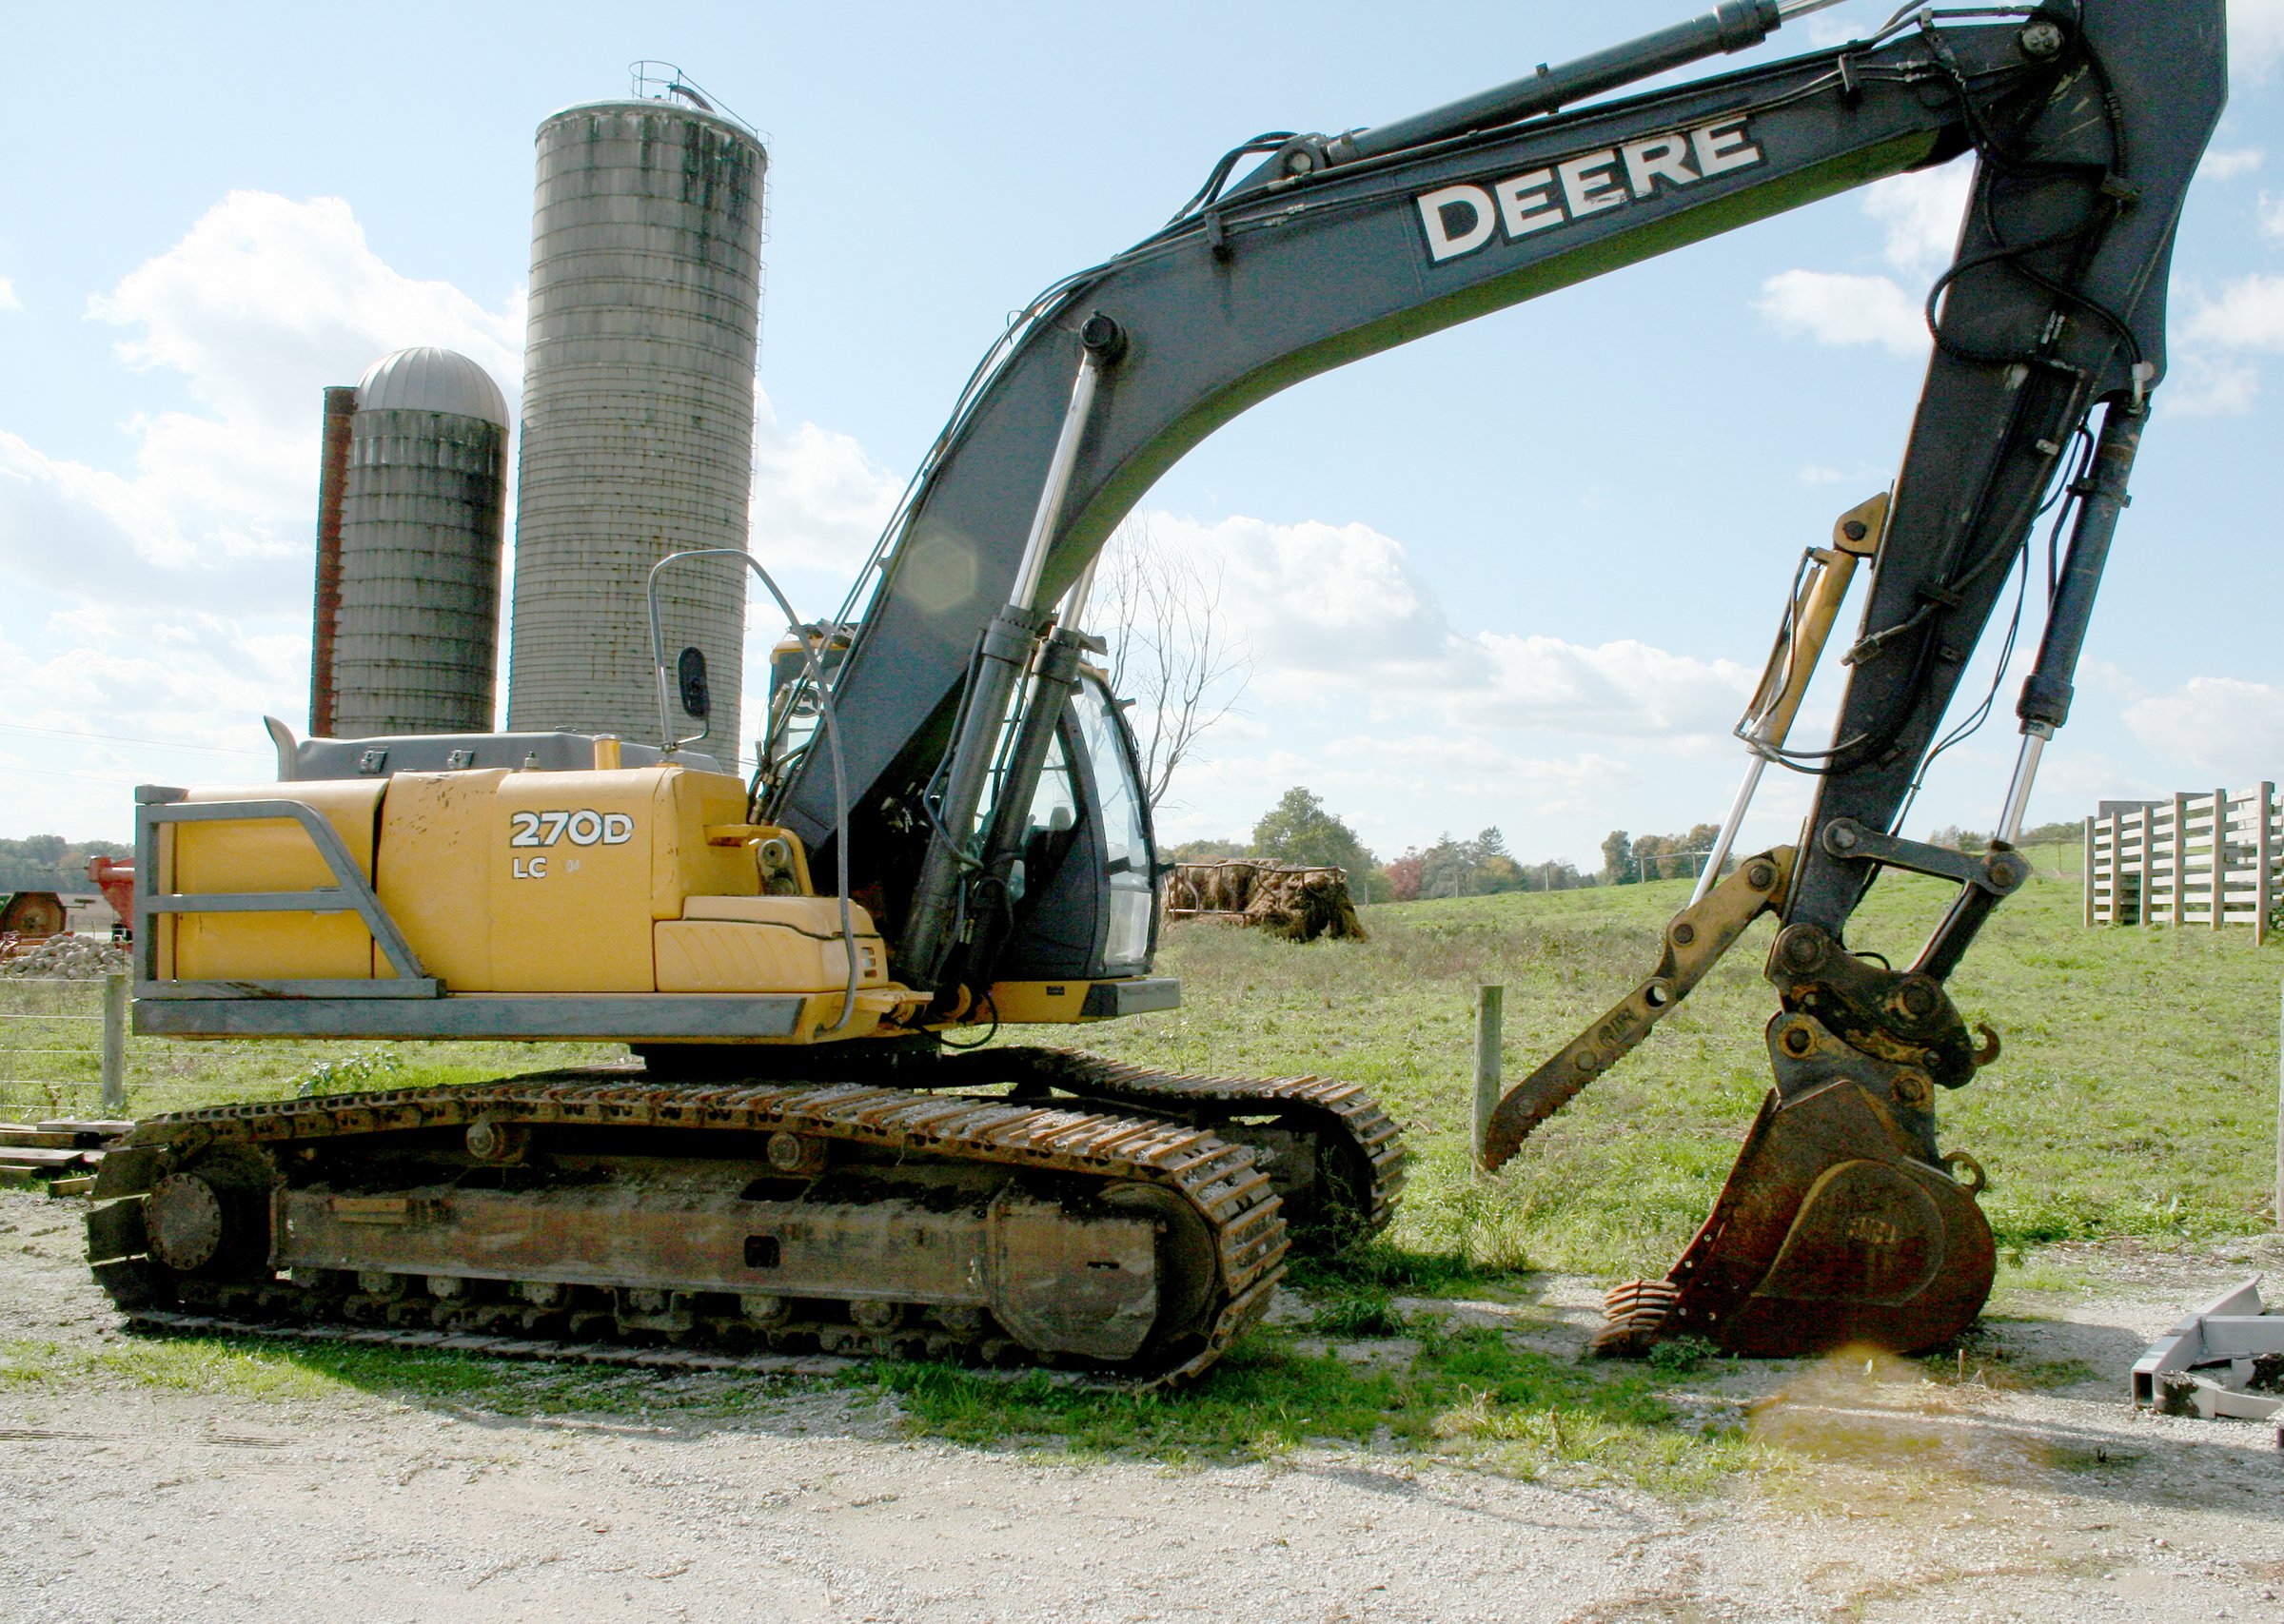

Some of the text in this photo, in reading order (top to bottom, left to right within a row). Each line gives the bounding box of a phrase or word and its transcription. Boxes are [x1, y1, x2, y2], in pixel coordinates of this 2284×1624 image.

[1417, 115, 1761, 263] DEERE
[511, 810, 634, 848] 270D
[513, 856, 547, 879] LC
